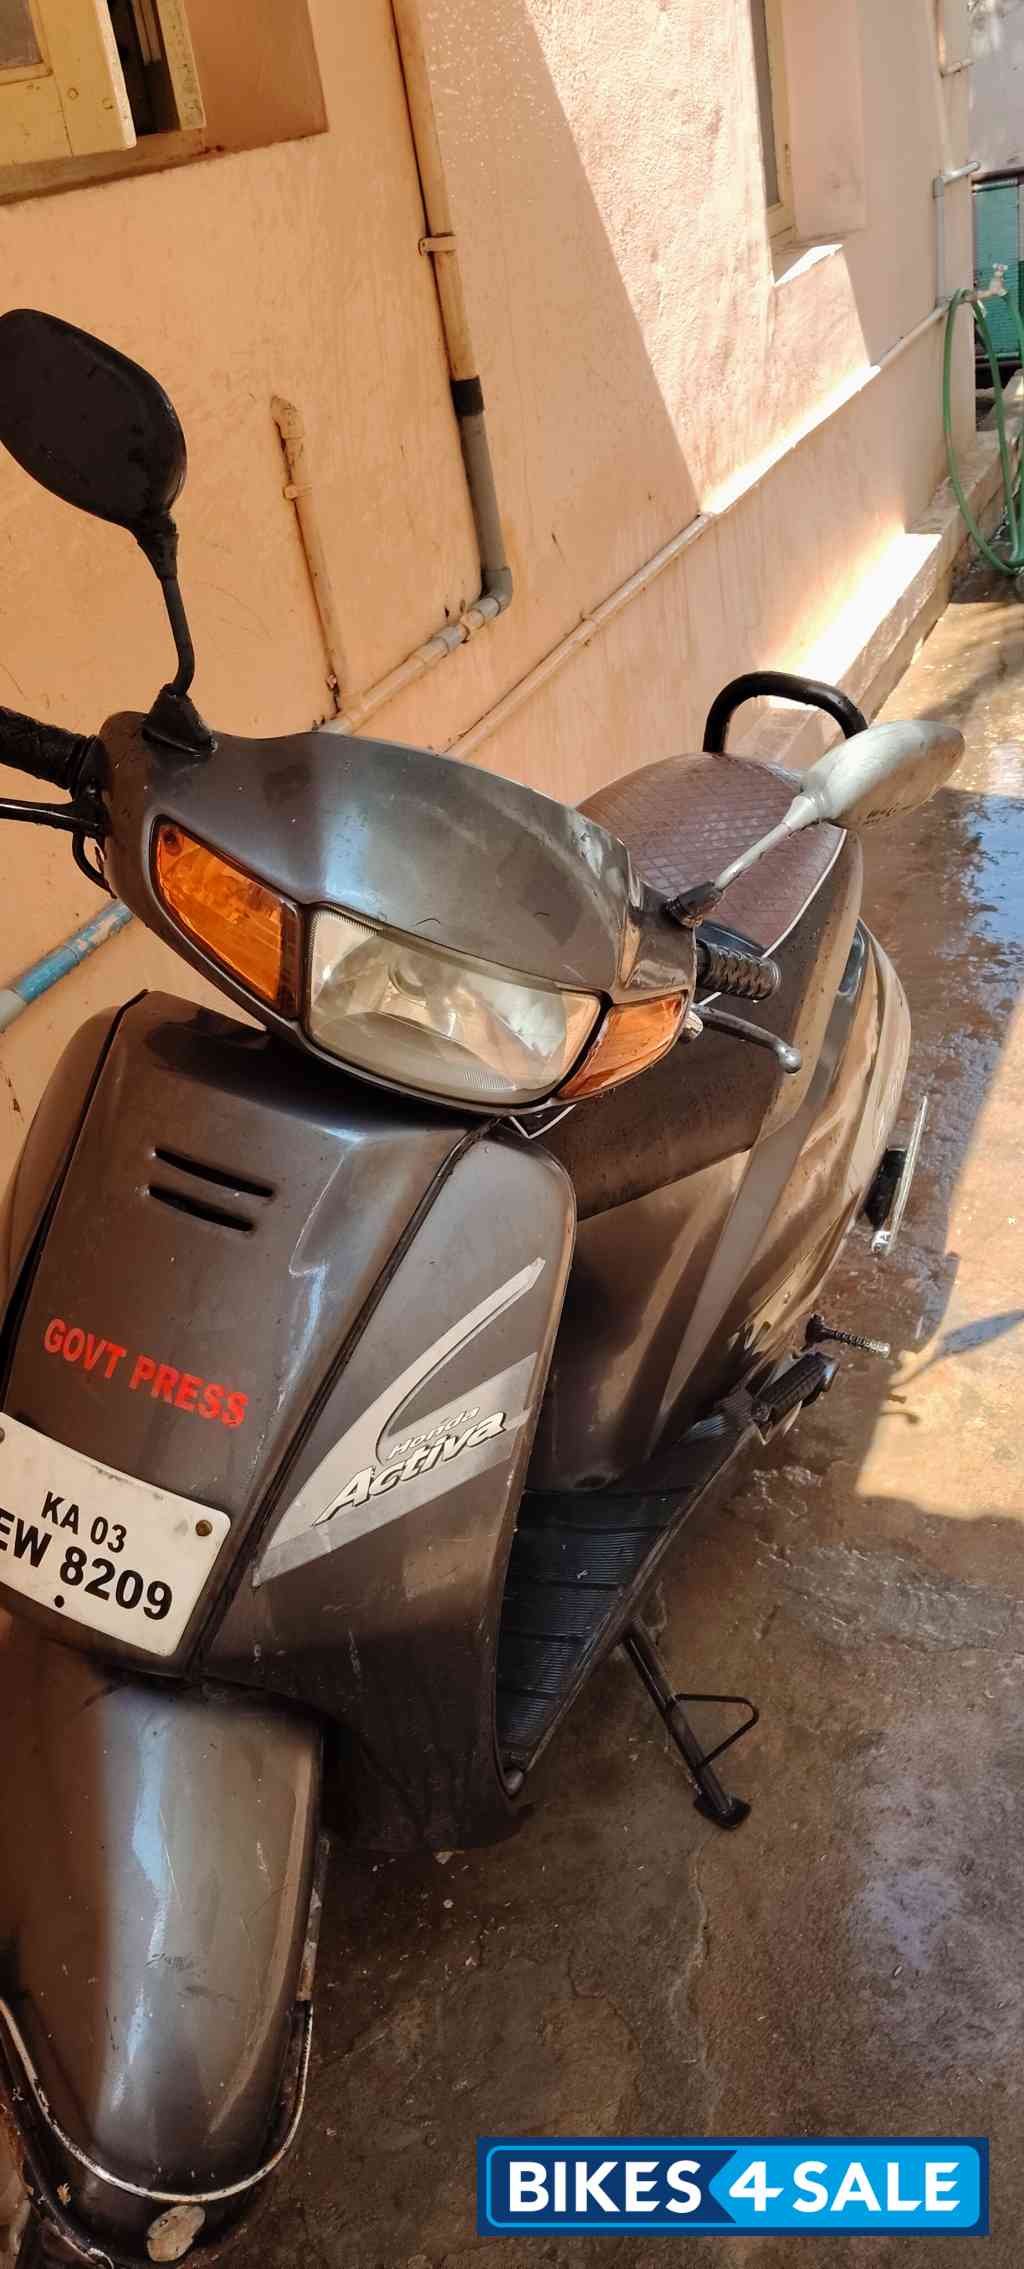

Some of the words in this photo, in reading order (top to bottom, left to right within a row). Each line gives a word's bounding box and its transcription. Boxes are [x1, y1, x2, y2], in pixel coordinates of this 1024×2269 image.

[44, 1317, 127, 1379] GOVT
[129, 1354, 249, 1428] PRESS
[310, 1411, 506, 1528] Activa
[386, 1406, 481, 1460] Honda
[41, 1490, 81, 1535] KA
[89, 1516, 128, 1554] 03
[59, 1546, 173, 1621] 8209
